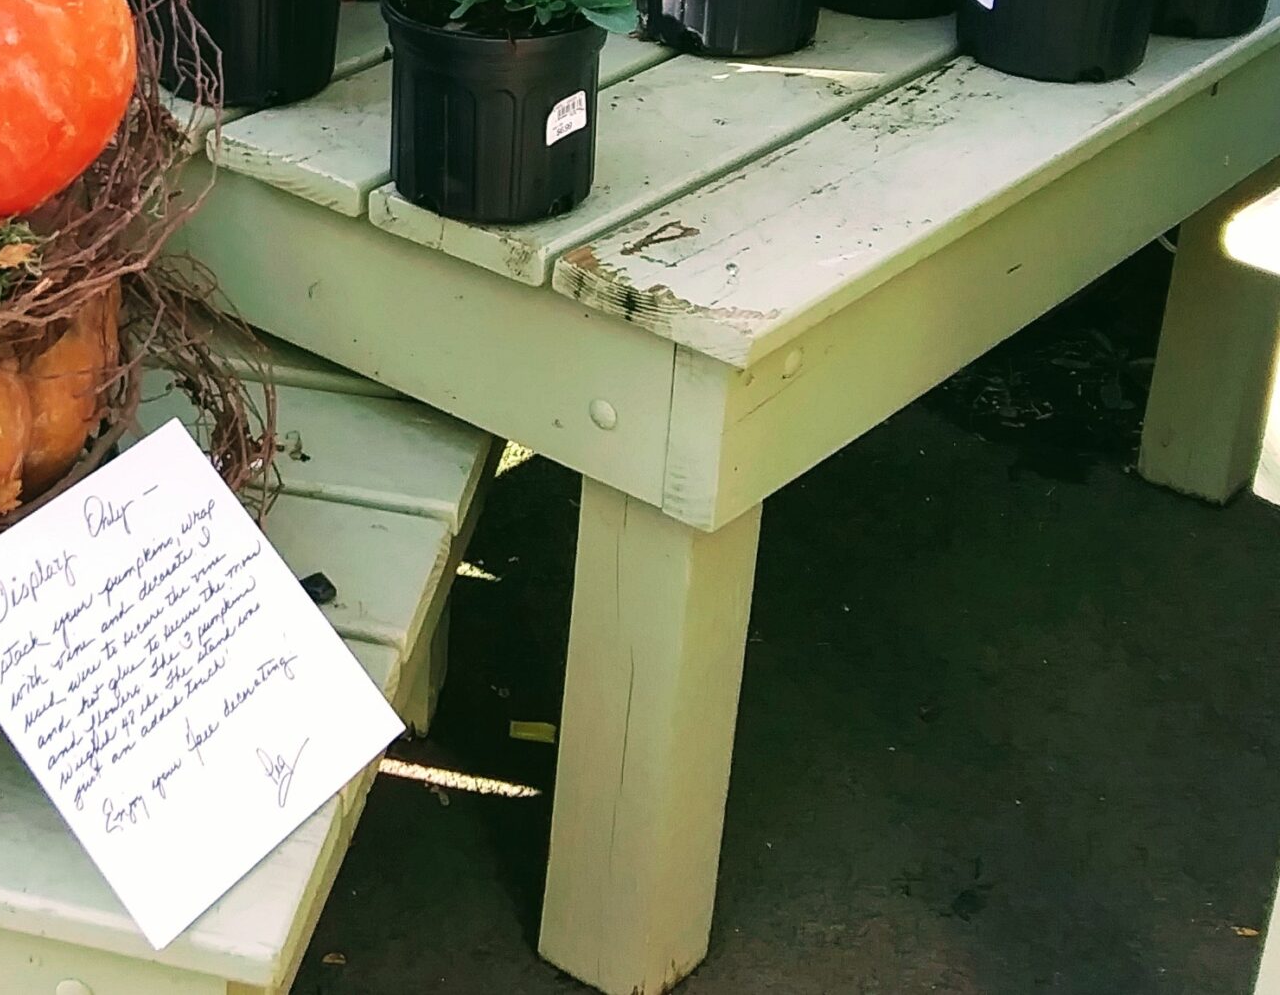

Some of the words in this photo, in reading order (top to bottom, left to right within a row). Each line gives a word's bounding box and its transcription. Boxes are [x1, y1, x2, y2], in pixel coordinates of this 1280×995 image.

[53, 593, 93, 649] your
[181, 499, 216, 535] wrap
[84, 495, 134, 538] Only
[11, 664, 49, 711] with
[51, 638, 96, 671] vine
[101, 601, 135, 633] and
[23, 691, 67, 734] used
[68, 659, 102, 693] wire
[101, 639, 119, 661] to
[123, 607, 164, 648] secure
[165, 585, 191, 606] the
[191, 553, 227, 583] vine
[37, 715, 71, 749] and
[77, 683, 104, 716] hot
[108, 658, 147, 699] glue
[144, 634, 160, 656] to
[163, 605, 201, 642] secure
[199, 579, 226, 603] the
[225, 539, 261, 578] moss
[48, 730, 83, 771] and
[149, 651, 181, 678] The
[178, 630, 194, 650] 3
[197, 574, 257, 646] pumpkins
[197, 625, 237, 664] stand
[238, 602, 261, 628] was
[74, 763, 103, 811] just
[111, 741, 136, 764] an
[140, 695, 183, 738] added
[102, 795, 151, 833] Enjoy
[151, 758, 182, 799] your
